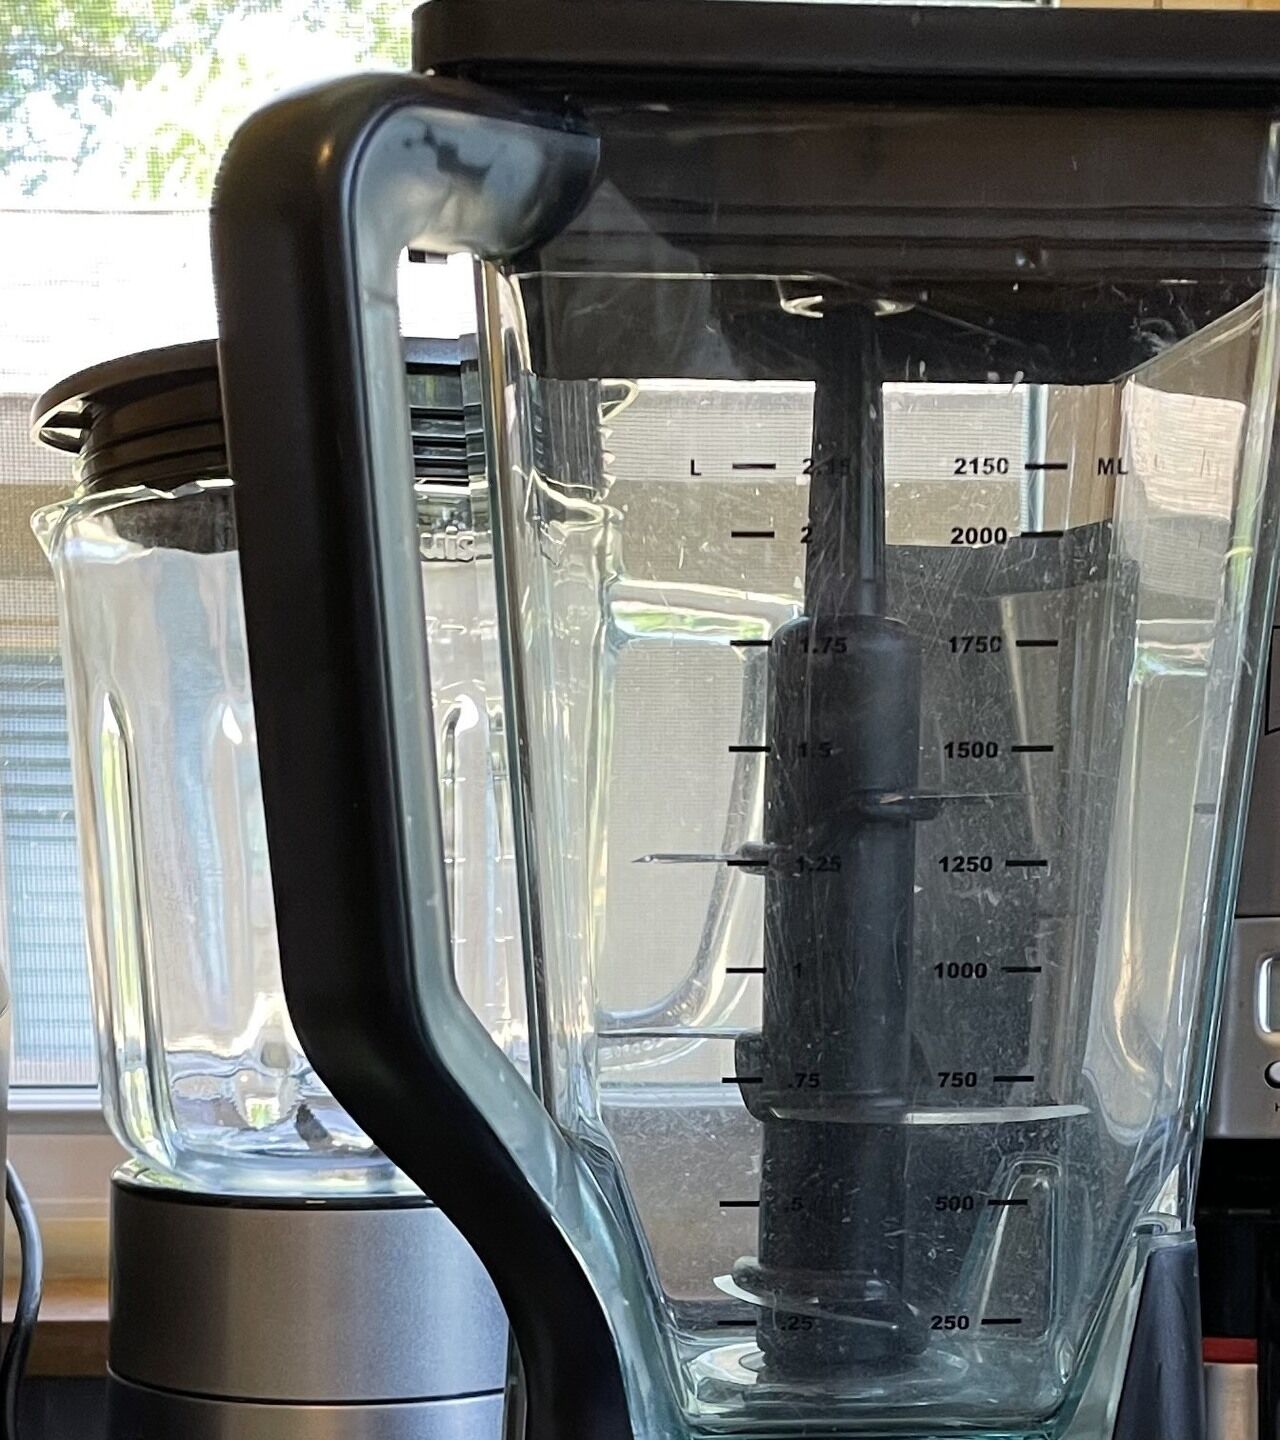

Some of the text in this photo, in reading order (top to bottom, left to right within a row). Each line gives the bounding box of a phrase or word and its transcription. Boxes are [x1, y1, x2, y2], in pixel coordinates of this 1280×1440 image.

[690, 458, 702, 476] L
[953, 457, 1129, 476] 2150 ML
[800, 526, 813, 544] 2
[950, 526, 1008, 545] 2000
[799, 635, 849, 655] 1.75
[947, 635, 1003, 654] 1750
[797, 741, 833, 759] 1.5
[943, 741, 999, 760] 1500
[794, 855, 842, 874] 1.25
[937, 855, 994, 873] 1250
[933, 961, 989, 979] 1000
[937, 1071, 978, 1088] 750
[934, 1194, 975, 1212] 500
[929, 1314, 971, 1331] 250
